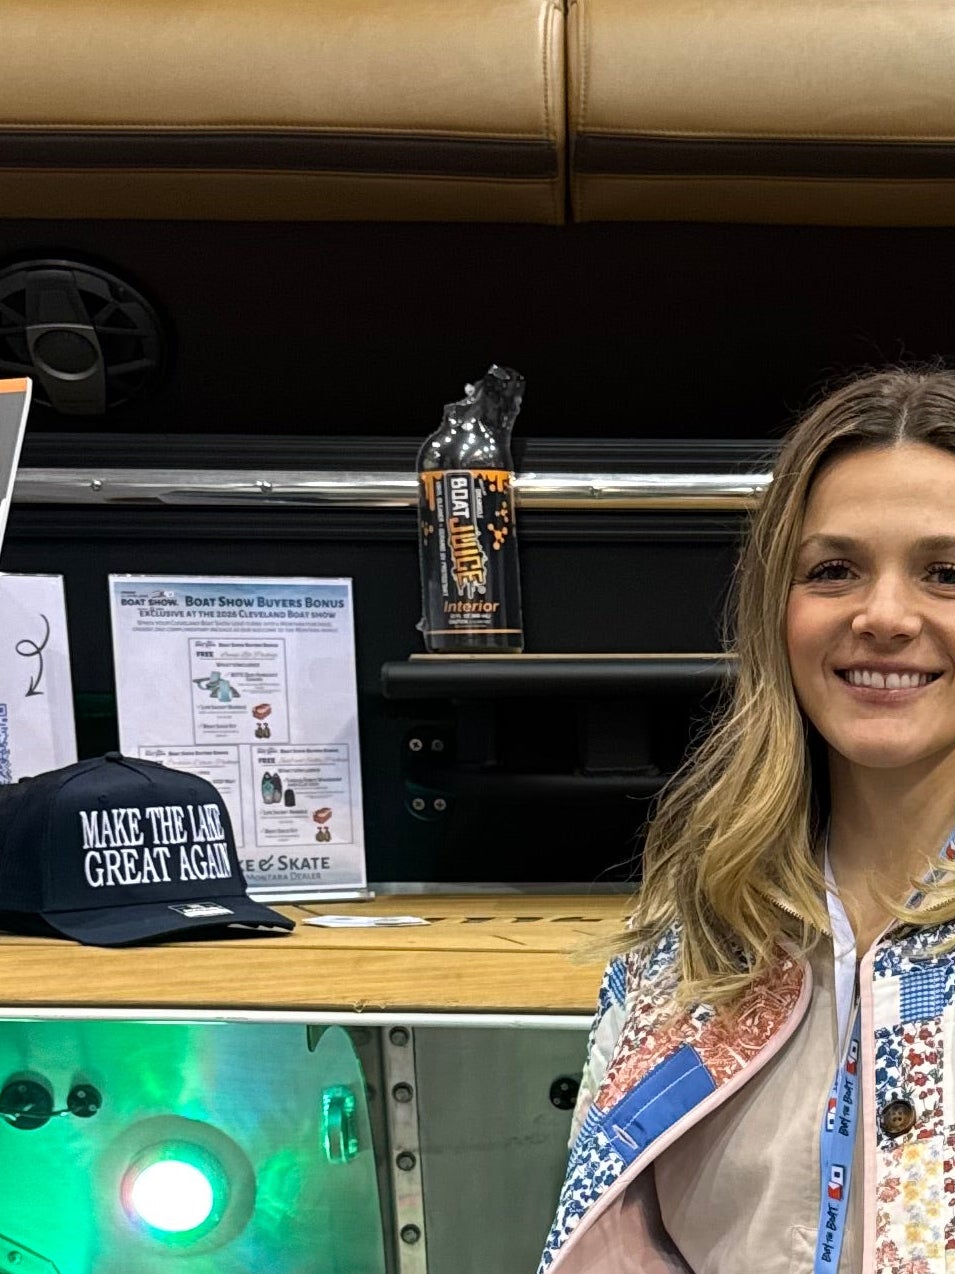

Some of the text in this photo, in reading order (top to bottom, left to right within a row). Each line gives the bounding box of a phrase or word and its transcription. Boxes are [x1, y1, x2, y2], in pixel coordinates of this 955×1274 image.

[450, 477, 470, 519] BOAT
[449, 518, 483, 588] JUICE
[139, 609, 185, 618] EXCLUSIVE
[199, 610, 214, 618] THE
[443, 600, 500, 613] Interior
[79, 803, 225, 850] MAKE THE LAKE
[84, 842, 232, 888] GREAT AGAIN
[278, 855, 331, 871] SKATE
